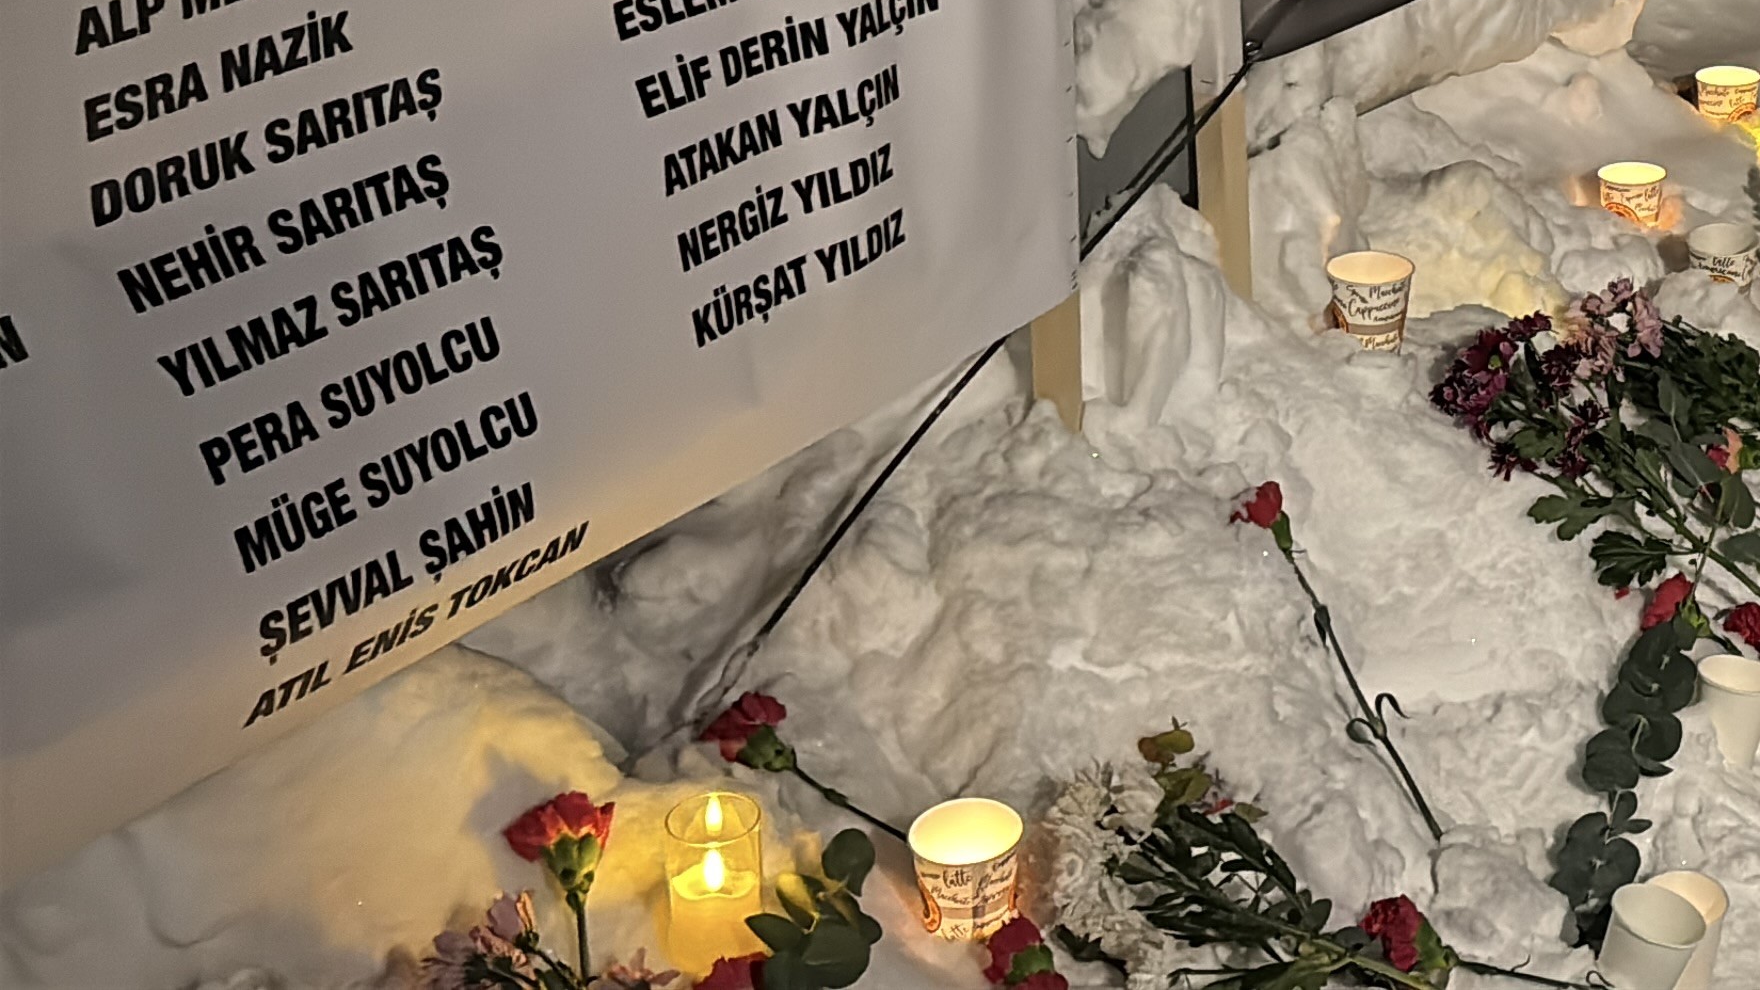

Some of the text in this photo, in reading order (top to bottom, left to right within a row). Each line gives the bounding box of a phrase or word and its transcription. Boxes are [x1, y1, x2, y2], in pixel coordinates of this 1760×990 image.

[84, 10, 353, 142] ESRA NAZİK
[635, 54, 712, 118] ELİF
[720, 15, 829, 87] DERİN
[664, 64, 900, 197] ATAKAN YALÇIN
[90, 68, 443, 227] DORUK SARITAŞ
[677, 143, 893, 273] NERGİZ YILDIZ
[117, 154, 450, 313] NEHİR SARITAŞ
[158, 225, 503, 397] YILMAZ SARITAŞ
[691, 208, 906, 348] KÜRŞAT YILDIZ
[199, 317, 500, 486] PERA SUYOLCU
[233, 392, 538, 574] MÜGE SUYOLCU
[242, 521, 589, 729] ATIL ENİS TOKCAN
[259, 482, 537, 666] ŞEVVAL ŞAHİN
